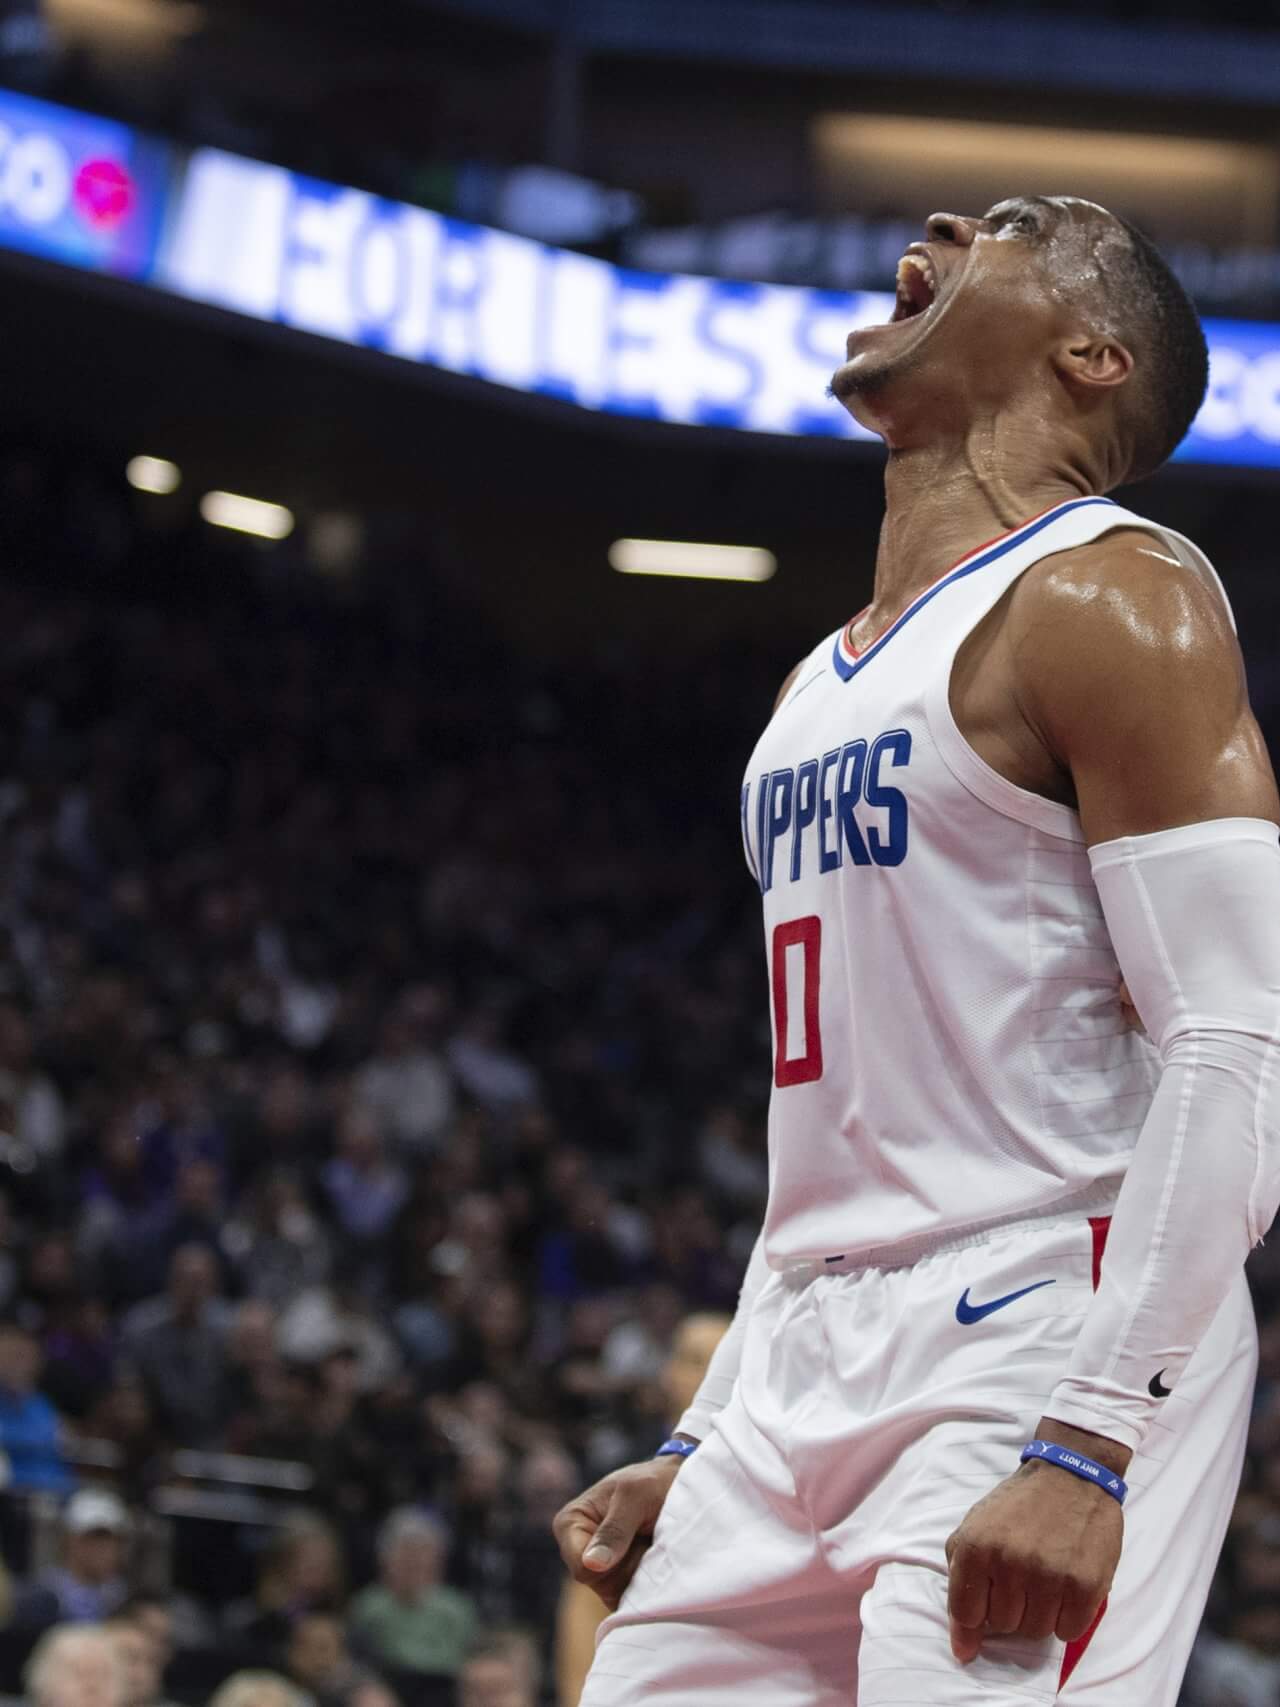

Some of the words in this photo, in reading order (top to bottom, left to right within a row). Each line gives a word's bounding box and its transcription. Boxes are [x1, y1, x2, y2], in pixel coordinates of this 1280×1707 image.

[741, 728, 912, 896] LIPPERS
[773, 915, 822, 1088] 0
[1081, 1462, 1099, 1477] WHY
